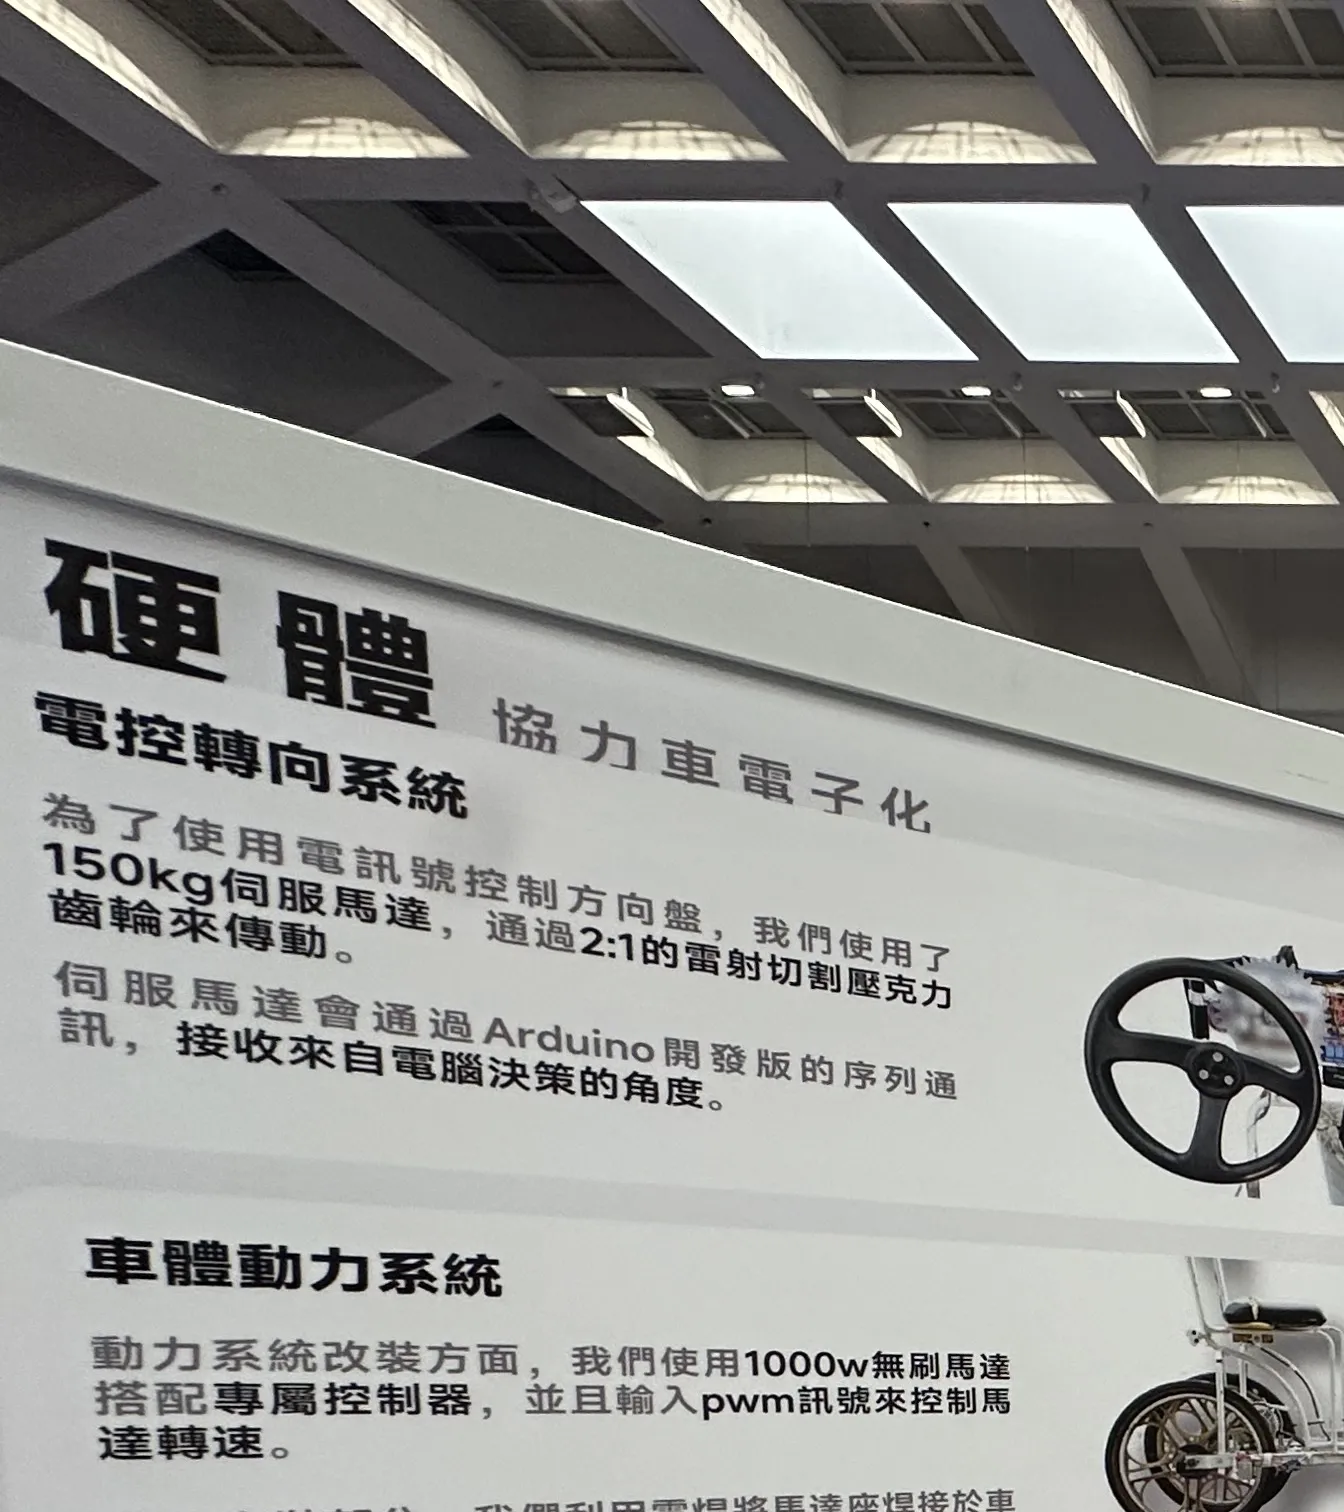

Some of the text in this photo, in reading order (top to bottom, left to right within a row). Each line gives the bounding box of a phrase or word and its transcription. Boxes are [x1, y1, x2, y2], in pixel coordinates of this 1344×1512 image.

[45, 538, 436, 729] 硬體
[34, 692, 469, 820] 電控轉向系統
[492, 698, 934, 834] 協力車電子化
[41, 793, 952, 973] 為了使用電訊號控制方向盤，我們使用了
[47, 888, 355, 966] 齒輪來傳動。
[59, 1009, 727, 1113] 訊，接收來自電腦決策的角度。
[85, 1238, 503, 1298] 車體動力系統
[91, 1335, 1011, 1382] 動力系統改裝方面，我們使用1000w無刷馬達
[95, 1381, 1011, 1421] 搭配專屬控制器，並且輸入pwm訊號來控制馬
[98, 1424, 291, 1461] 達轉速。
